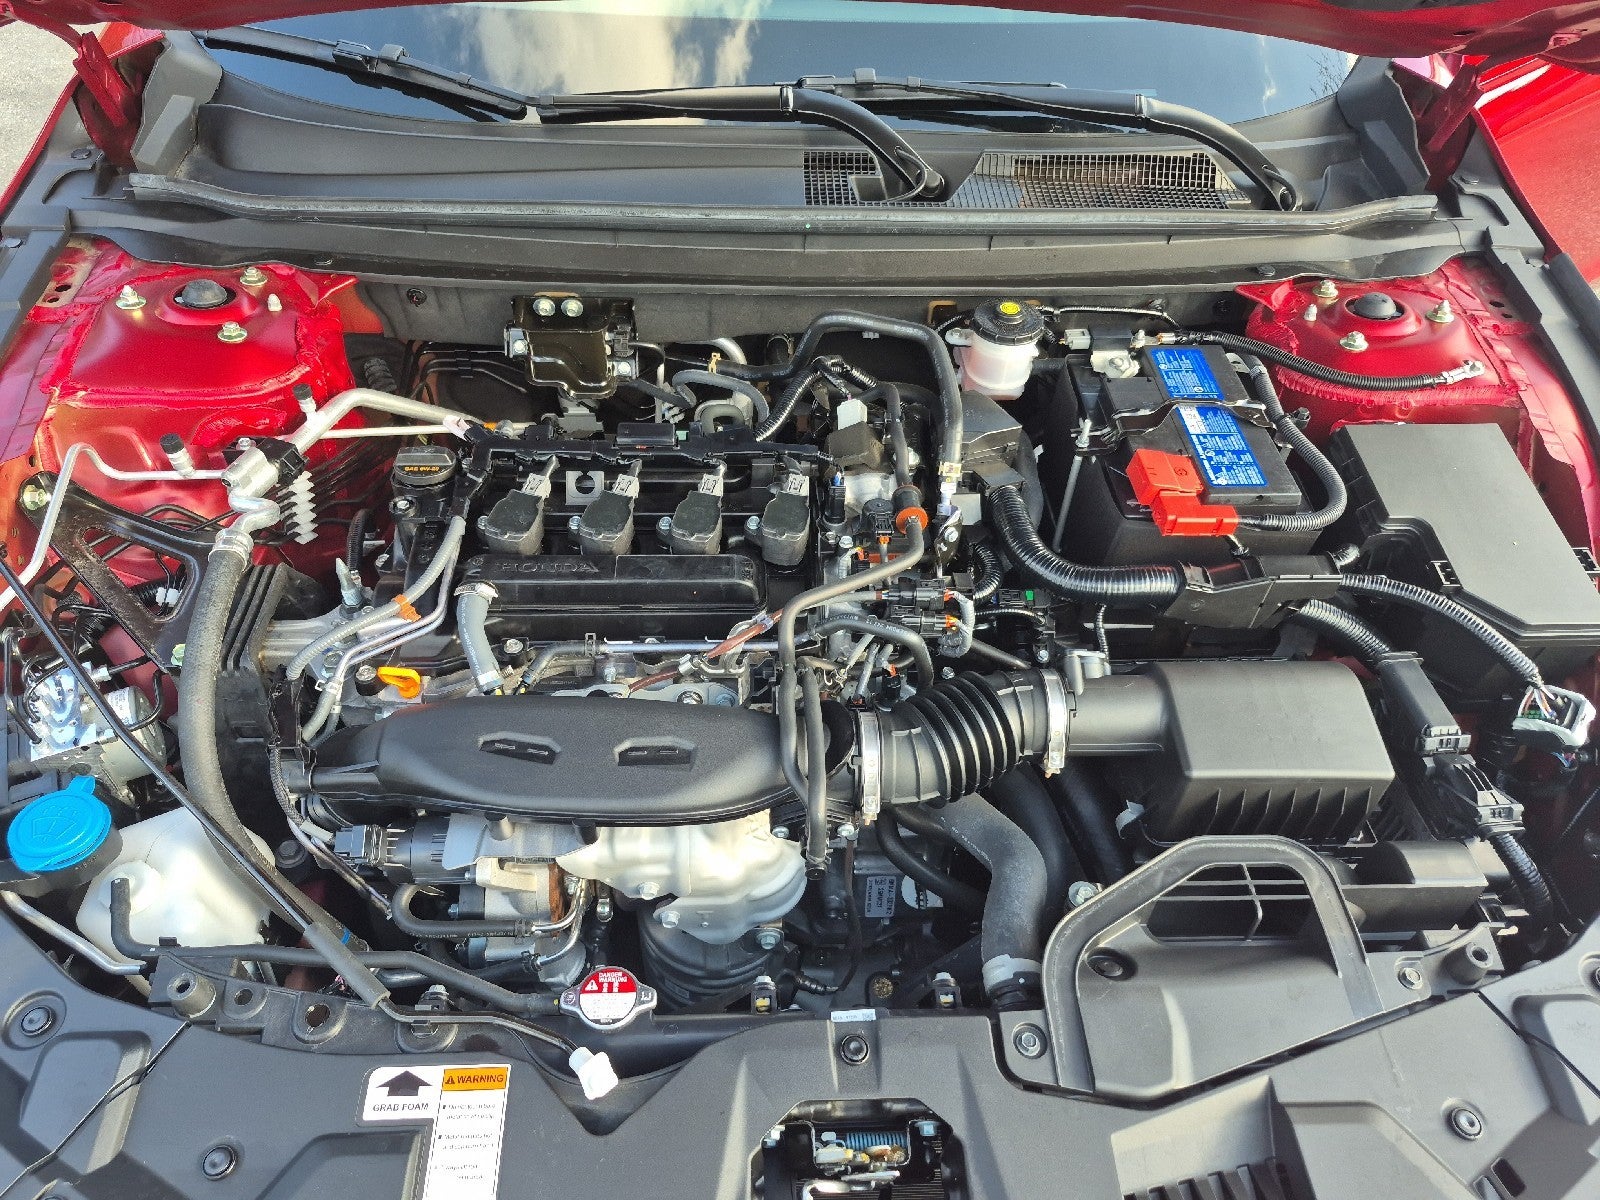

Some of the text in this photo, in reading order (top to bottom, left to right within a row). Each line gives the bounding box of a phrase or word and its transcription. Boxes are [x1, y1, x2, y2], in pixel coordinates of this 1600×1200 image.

[501, 562, 600, 573] HONDA
[457, 1074, 504, 1084] WARNING
[372, 1102, 429, 1112] GRAB FOAM
